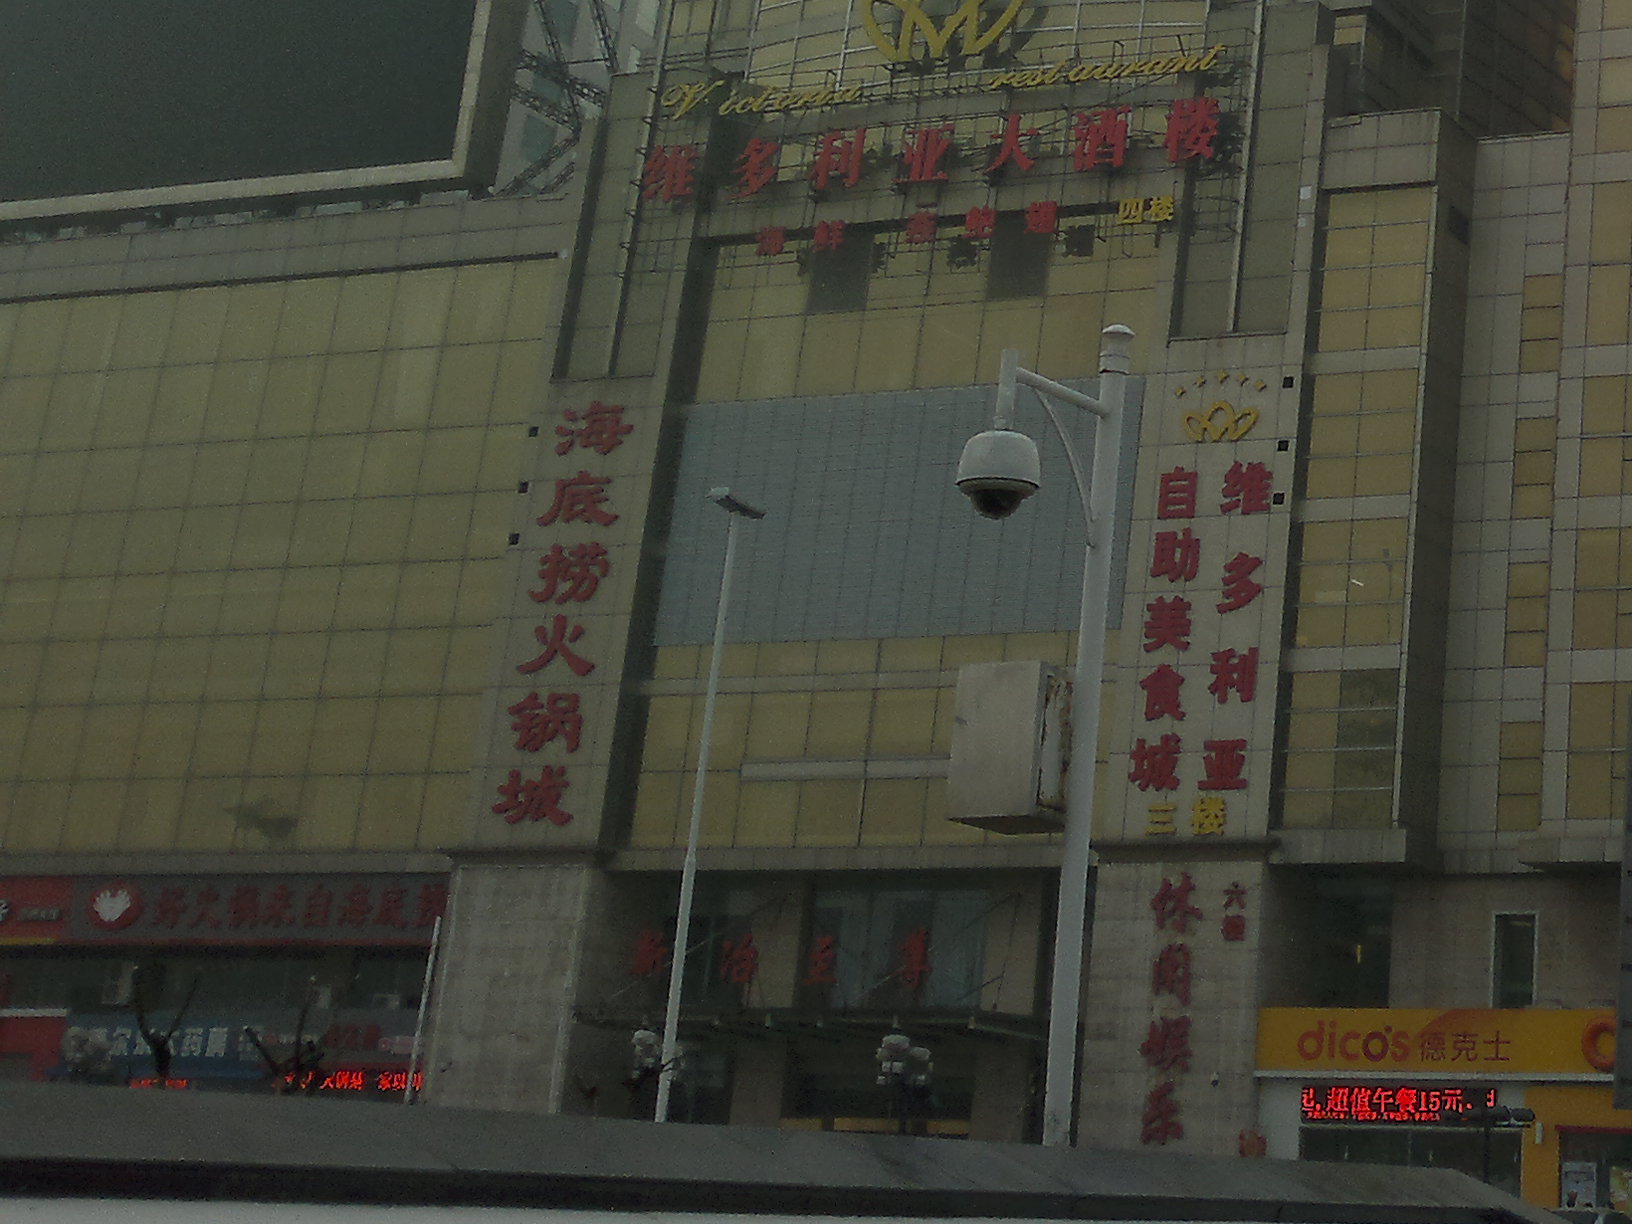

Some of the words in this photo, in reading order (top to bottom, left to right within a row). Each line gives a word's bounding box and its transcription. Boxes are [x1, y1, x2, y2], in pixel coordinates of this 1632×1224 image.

[660, 79, 863, 121] Victoria
[984, 44, 1227, 91] restaurant
[641, 97, 1220, 202] 维多利亚大酒楼
[1116, 195, 1174, 225] 四楼
[1127, 466, 1199, 792] 自助美食城
[1196, 460, 1269, 791] 维多利亚
[1144, 797, 1226, 836] 三楼
[1297, 1020, 1408, 1063] dico's
[1418, 1031, 1510, 1062] 德克士
